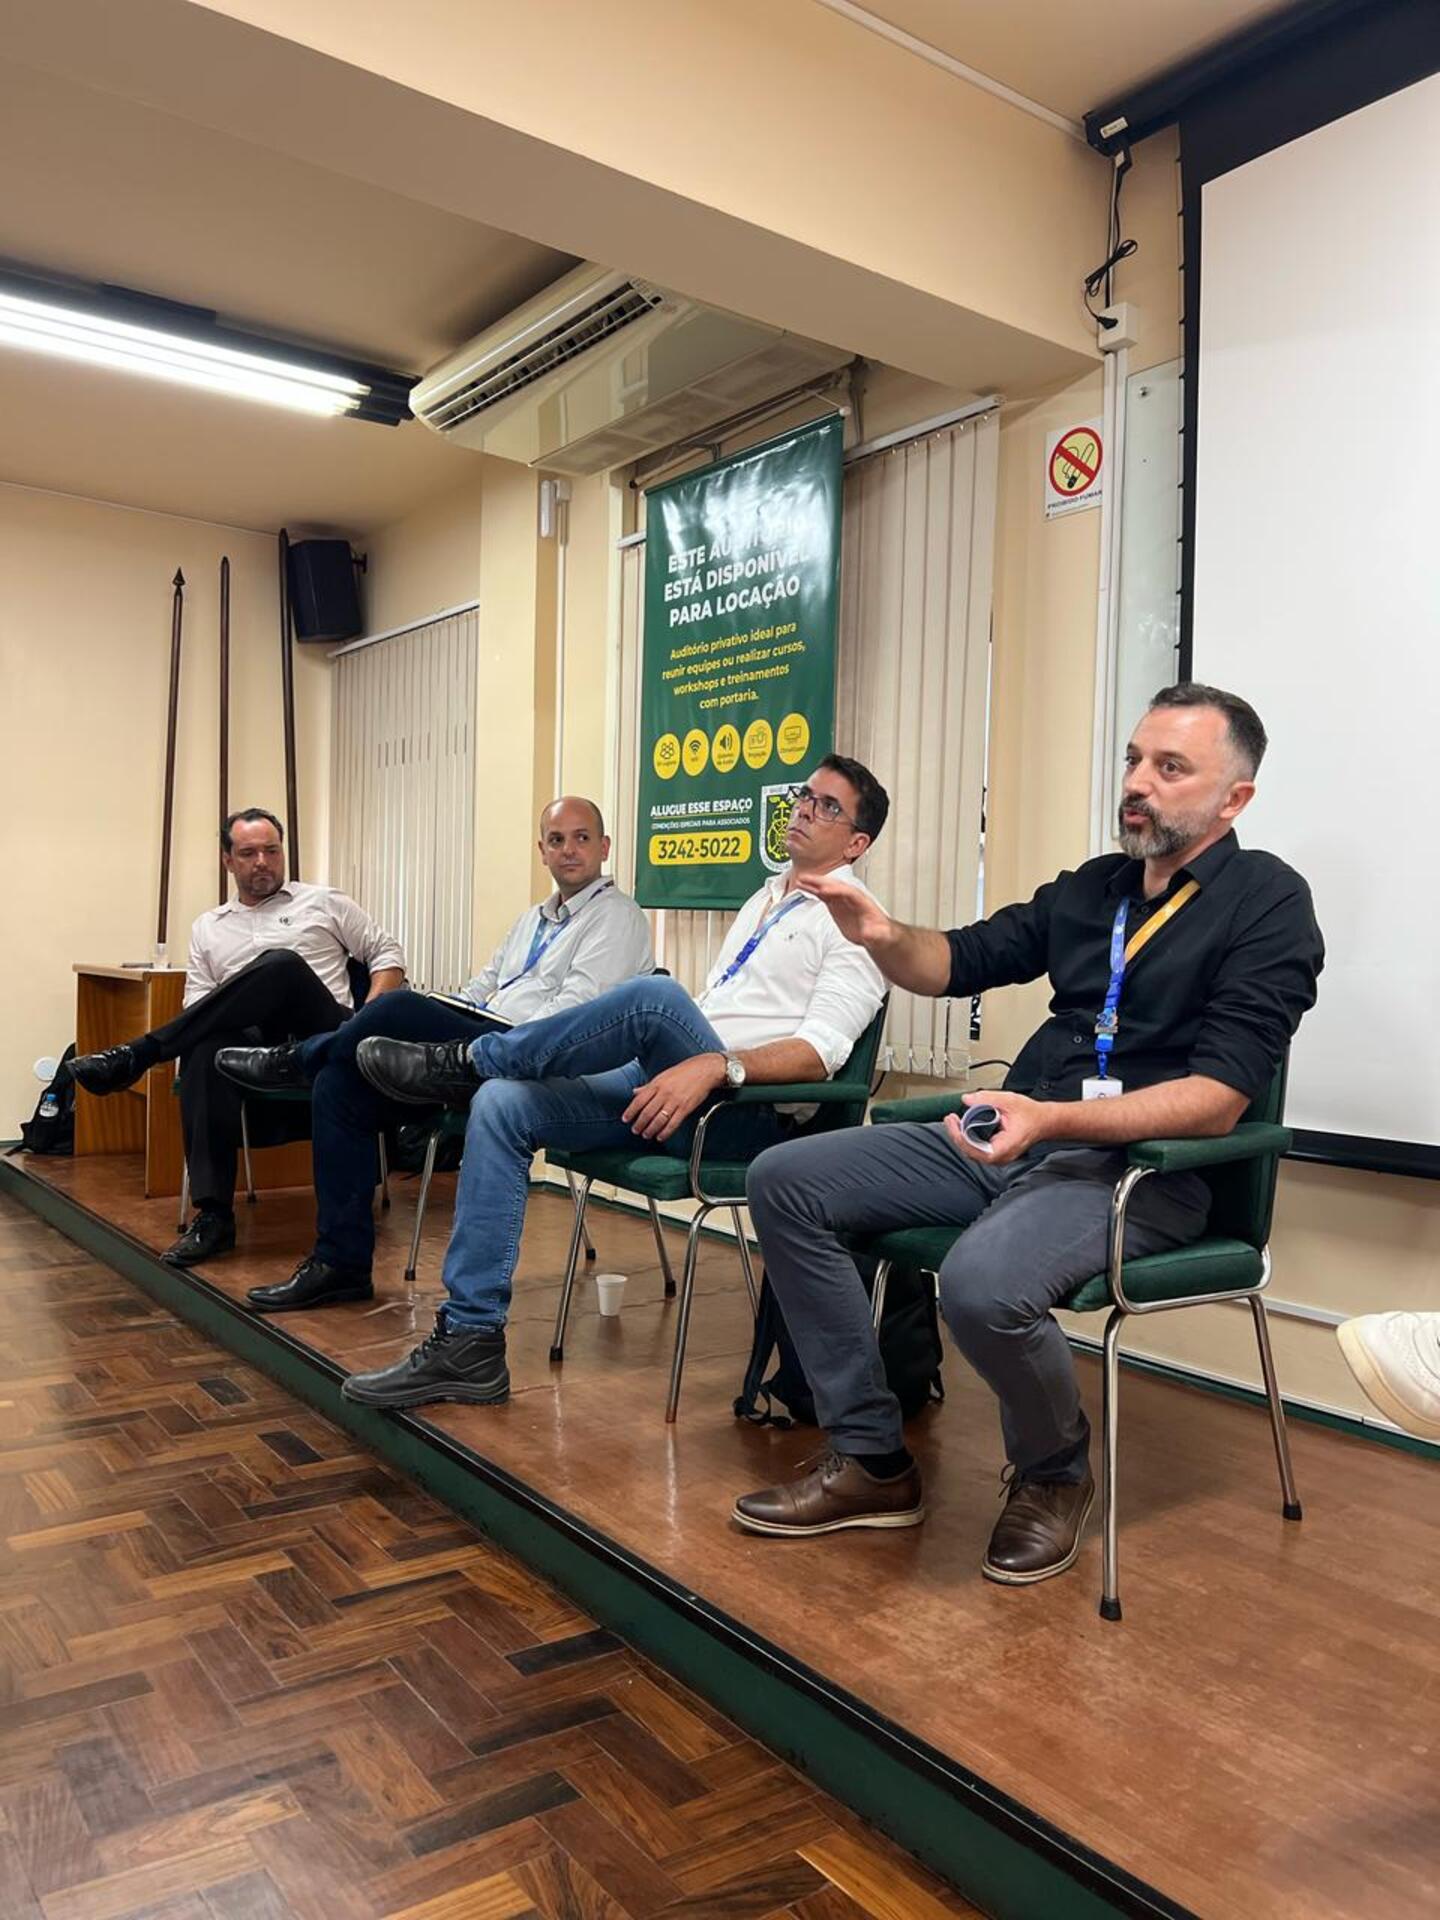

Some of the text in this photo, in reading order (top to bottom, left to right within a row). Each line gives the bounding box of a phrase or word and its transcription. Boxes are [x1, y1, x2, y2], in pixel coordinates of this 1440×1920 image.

[664, 545, 810, 602] ESTÁ DISPONÍVEL
[668, 544, 706, 574] ESTE
[669, 574, 800, 628] PARA LOCAÇÃO
[670, 622, 797, 660] Auditório privativo ideal para
[662, 664, 686, 680] reunir
[686, 659, 721, 676] equipes
[722, 656, 735, 667] ou
[736, 648, 771, 664] realizar
[673, 664, 790, 696] workshops e treinamentos
[699, 688, 759, 709] com portaria.
[650, 798, 753, 817] ALUGUE ESSE ESPAÇO
[658, 837, 741, 859] 3242-5022
